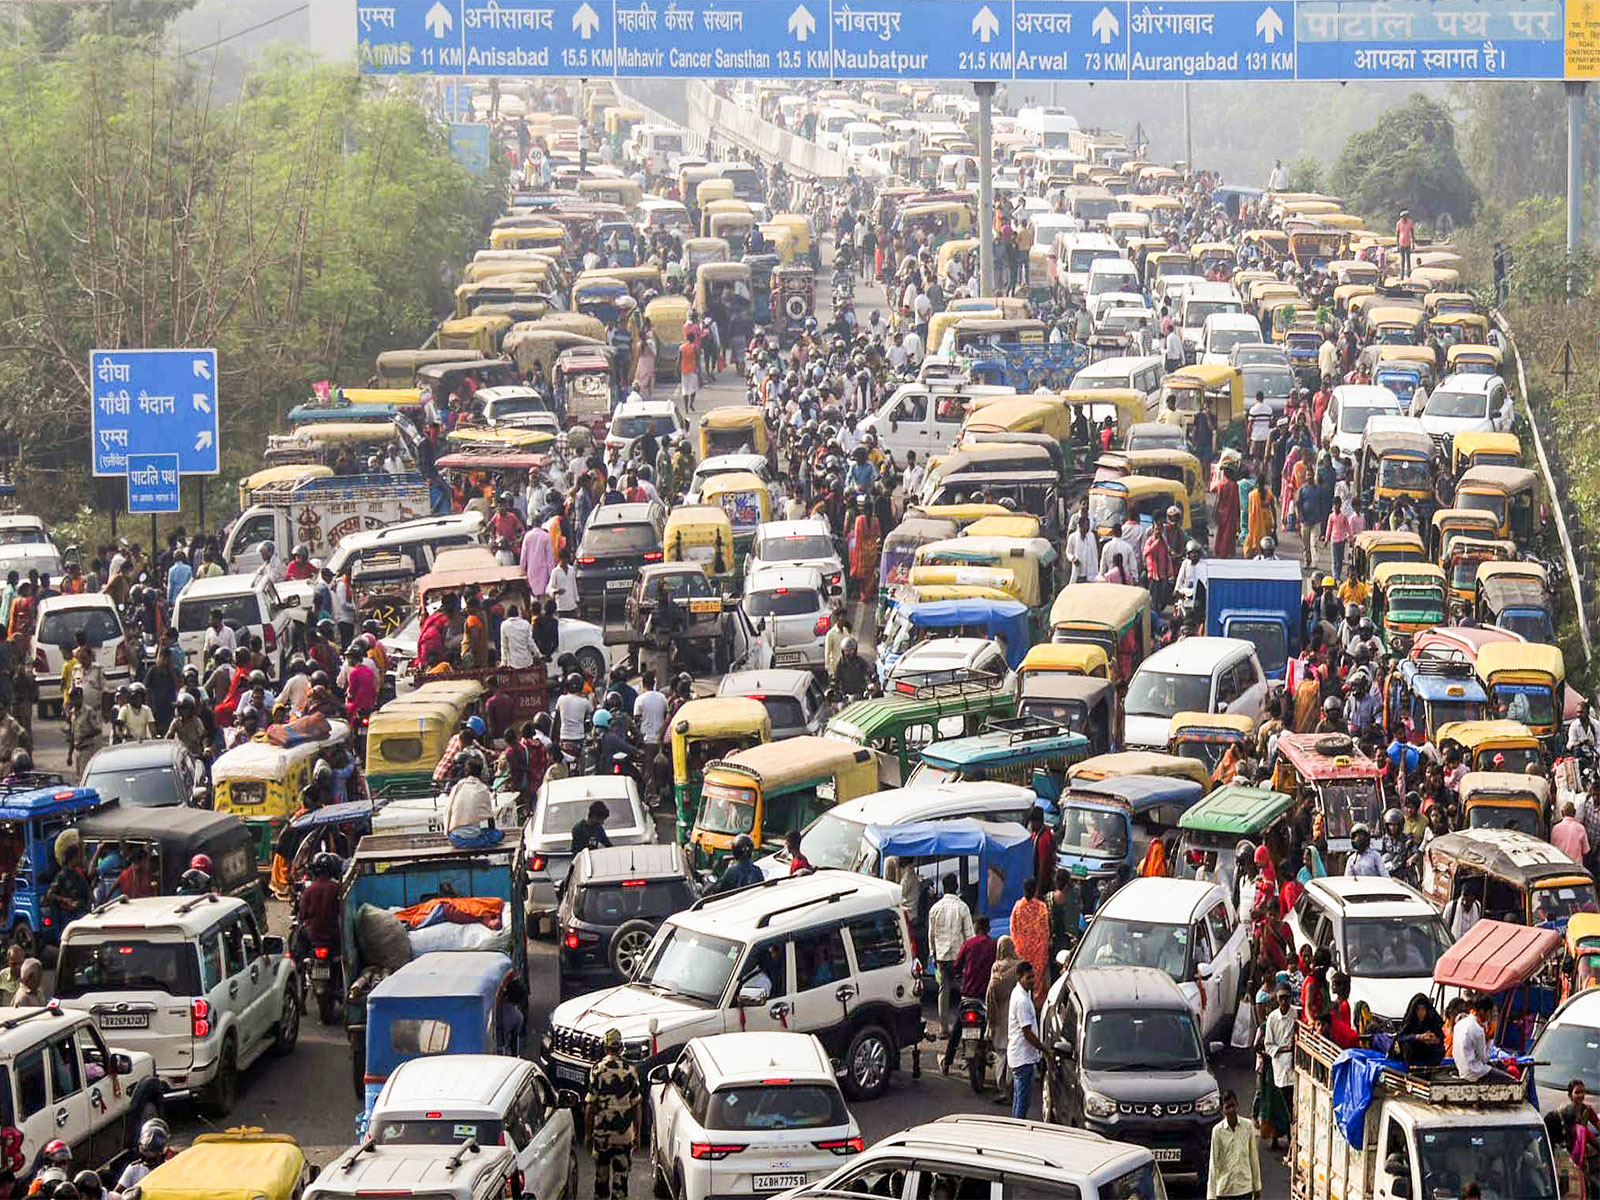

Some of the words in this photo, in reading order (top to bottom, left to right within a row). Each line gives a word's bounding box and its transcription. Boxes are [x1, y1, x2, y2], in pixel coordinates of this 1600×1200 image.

[359, 7, 395, 32] एम्स
[465, 0, 553, 29] अनीसाबाद
[617, 2, 657, 31] महावीर
[703, 3, 743, 31] संस्थान
[833, 4, 901, 41] नौबतपुर
[1016, 12, 1072, 34] अरवल
[1131, 5, 1214, 35] औरंगाबाद
[1303, 4, 1415, 38] पाटलि
[1432, 11, 1491, 37] पथ
[1507, 11, 1555, 37] पर
[361, 44, 411, 66] AIMS
[420, 47, 434, 65] 11
[440, 47, 462, 66] KM
[467, 47, 548, 67] Anisabad
[561, 48, 587, 67] 15.5
[591, 48, 613, 67] KM
[617, 48, 664, 68] Mahavir
[669, 49, 712, 68] Cancer
[715, 49, 770, 69] Sansthan
[776, 50, 801, 69] 13.5
[807, 50, 829, 69] KM
[834, 49, 928, 73] Naubatpur
[958, 51, 986, 70] 21.5
[990, 51, 1012, 70] KM
[1016, 51, 1067, 71] Arwal
[1085, 53, 1100, 71] 73
[1104, 53, 1126, 71] KM
[1132, 52, 1237, 75] Aurangabad
[1246, 53, 1267, 71] 131
[1271, 53, 1293, 71] KM
[1354, 49, 1416, 70] आपका
[1422, 49, 1478, 70] स्वागत
[98, 357, 130, 382] दीघा
[138, 389, 175, 414] मैदान
[99, 429, 128, 450] एम्स
[130, 464, 158, 485] पाटलि
[161, 470, 176, 485] पथ
